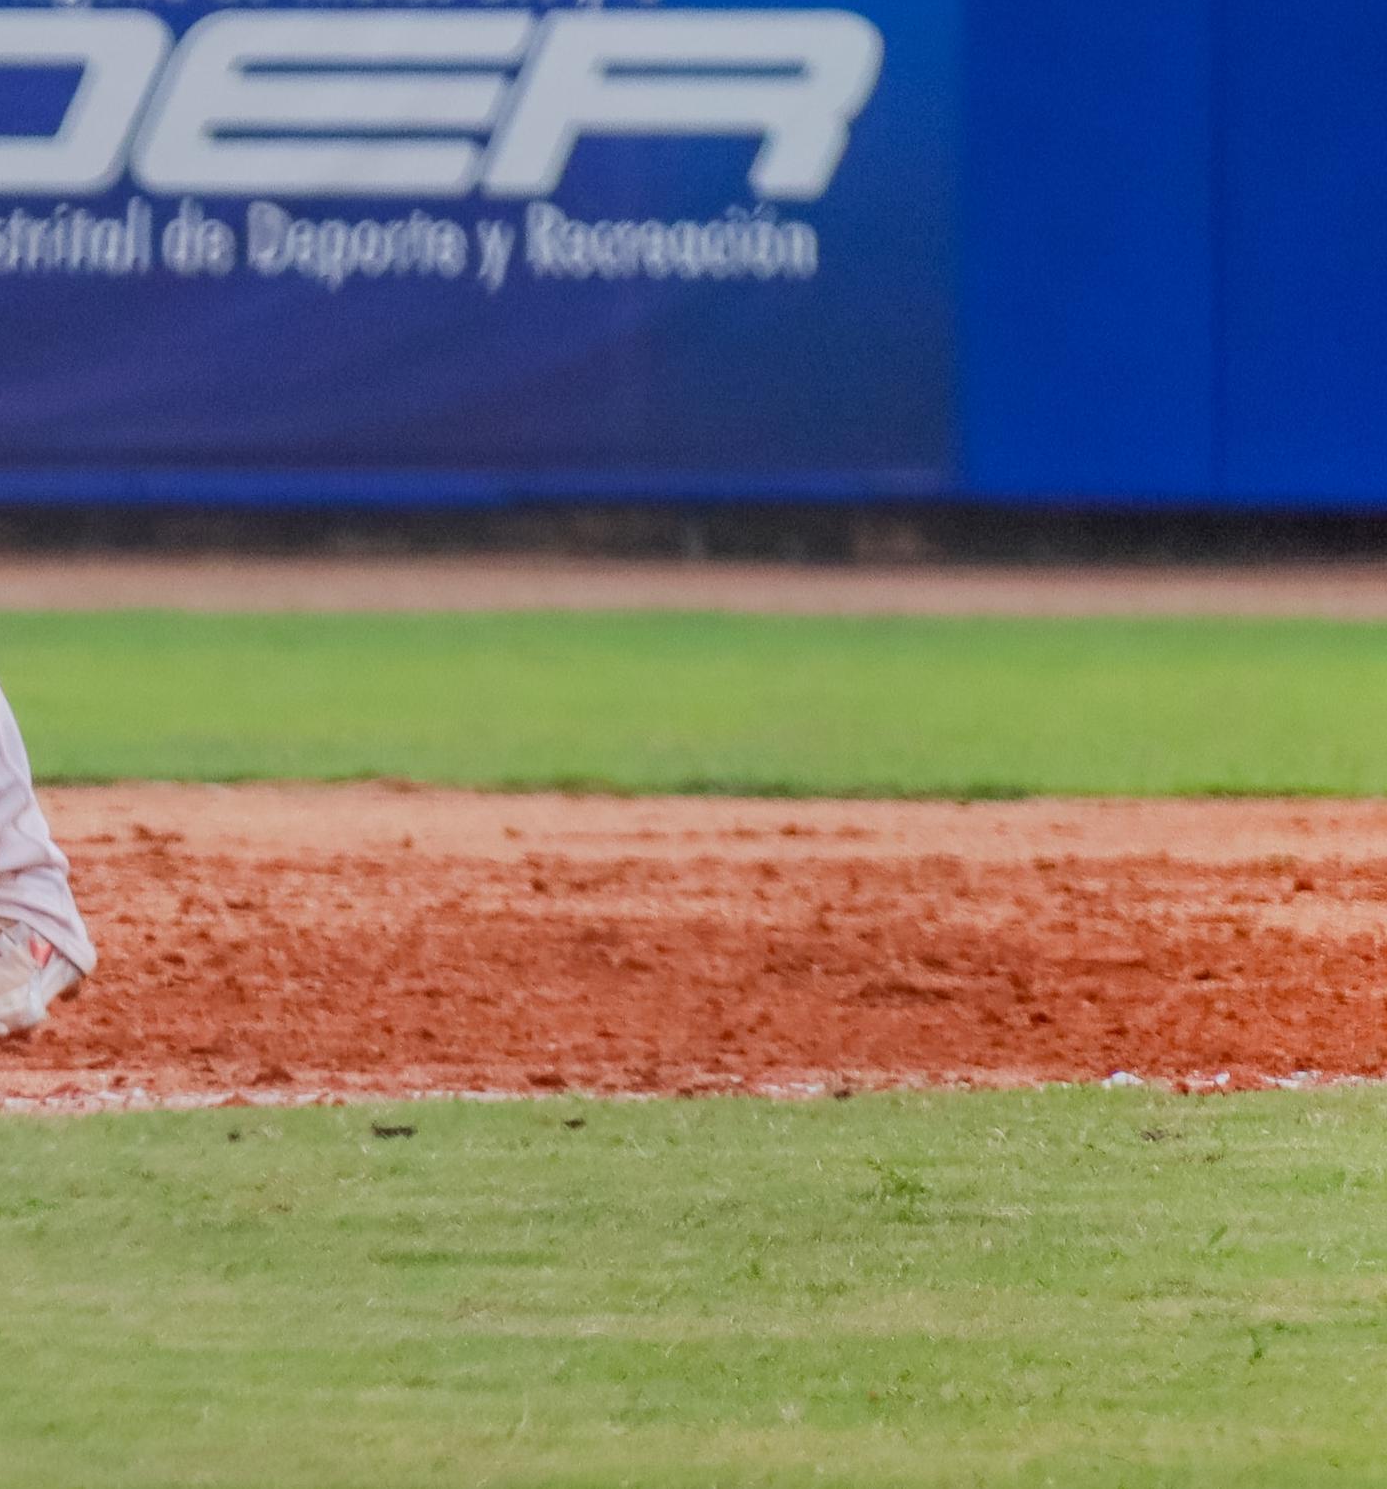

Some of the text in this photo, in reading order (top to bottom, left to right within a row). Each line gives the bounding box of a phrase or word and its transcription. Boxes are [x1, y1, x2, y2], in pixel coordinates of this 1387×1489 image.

[160, 194, 238, 280] de
[244, 200, 470, 293] Deporte
[475, 218, 518, 296] y
